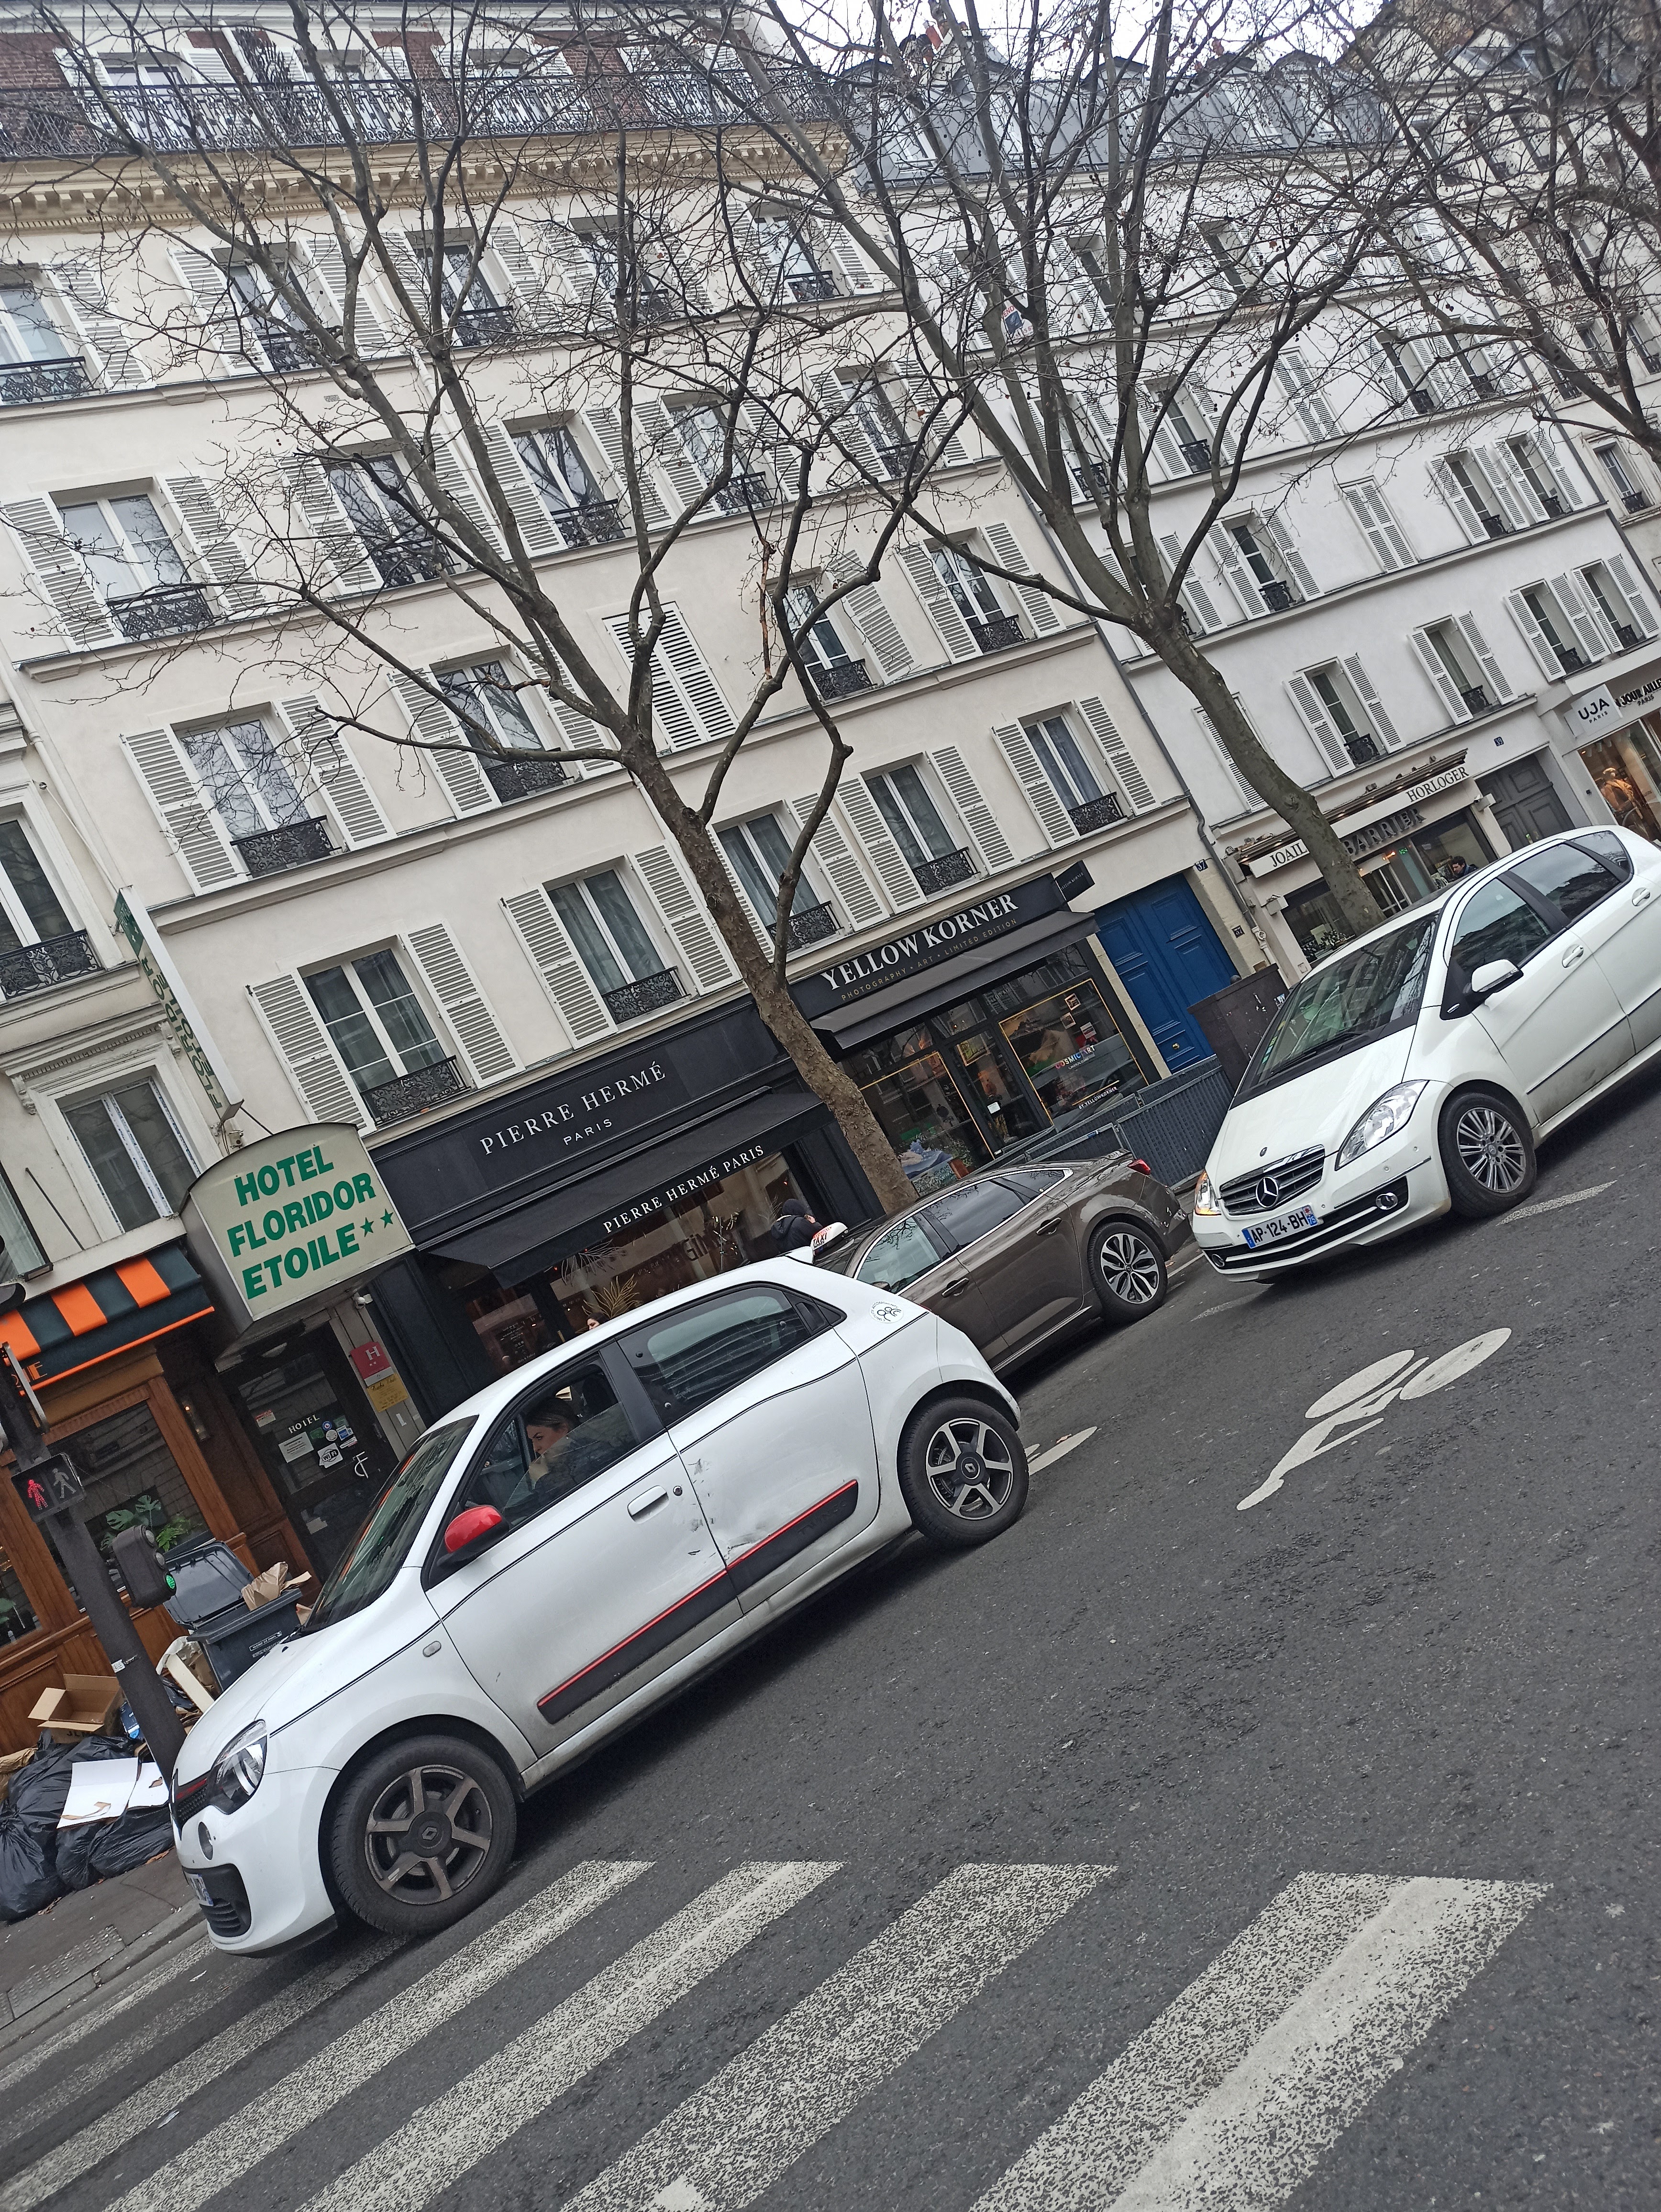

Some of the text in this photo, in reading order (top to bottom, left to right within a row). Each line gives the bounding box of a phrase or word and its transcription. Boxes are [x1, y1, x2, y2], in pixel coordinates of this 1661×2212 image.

[1578, 698, 1610, 720] UJA
[1620, 688, 1644, 706] JOUR
[1637, 694, 1655, 706] PARIS
[1589, 711, 1608, 723] PARIS
[1406, 767, 1470, 803] HORLOGER
[1341, 807, 1427, 857] BARRIER
[1196, 861, 1206, 871] 37
[819, 894, 1019, 990] YELLOW KORNER
[841, 918, 1018, 1001] PHOTOGRAPHY ART LIMITED EDITION
[141, 956, 223, 1109] FLORIDOR
[1055, 1052, 1082, 1069] COSMIC
[479, 1061, 666, 1156] PIERRE HERMÉ
[563, 1118, 613, 1145] PARIS
[234, 1145, 334, 1207] HOTEL
[603, 1145, 764, 1234] PIERRE HERMÉ PARIS
[227, 1172, 376, 1257] FLORIDOR
[1251, 1211, 1316, 1243] AP-124-BH 75
[813, 1232, 827, 1247] TAXI
[242, 1222, 360, 1300] ETOILE
[365, 1345, 381, 1360] H
